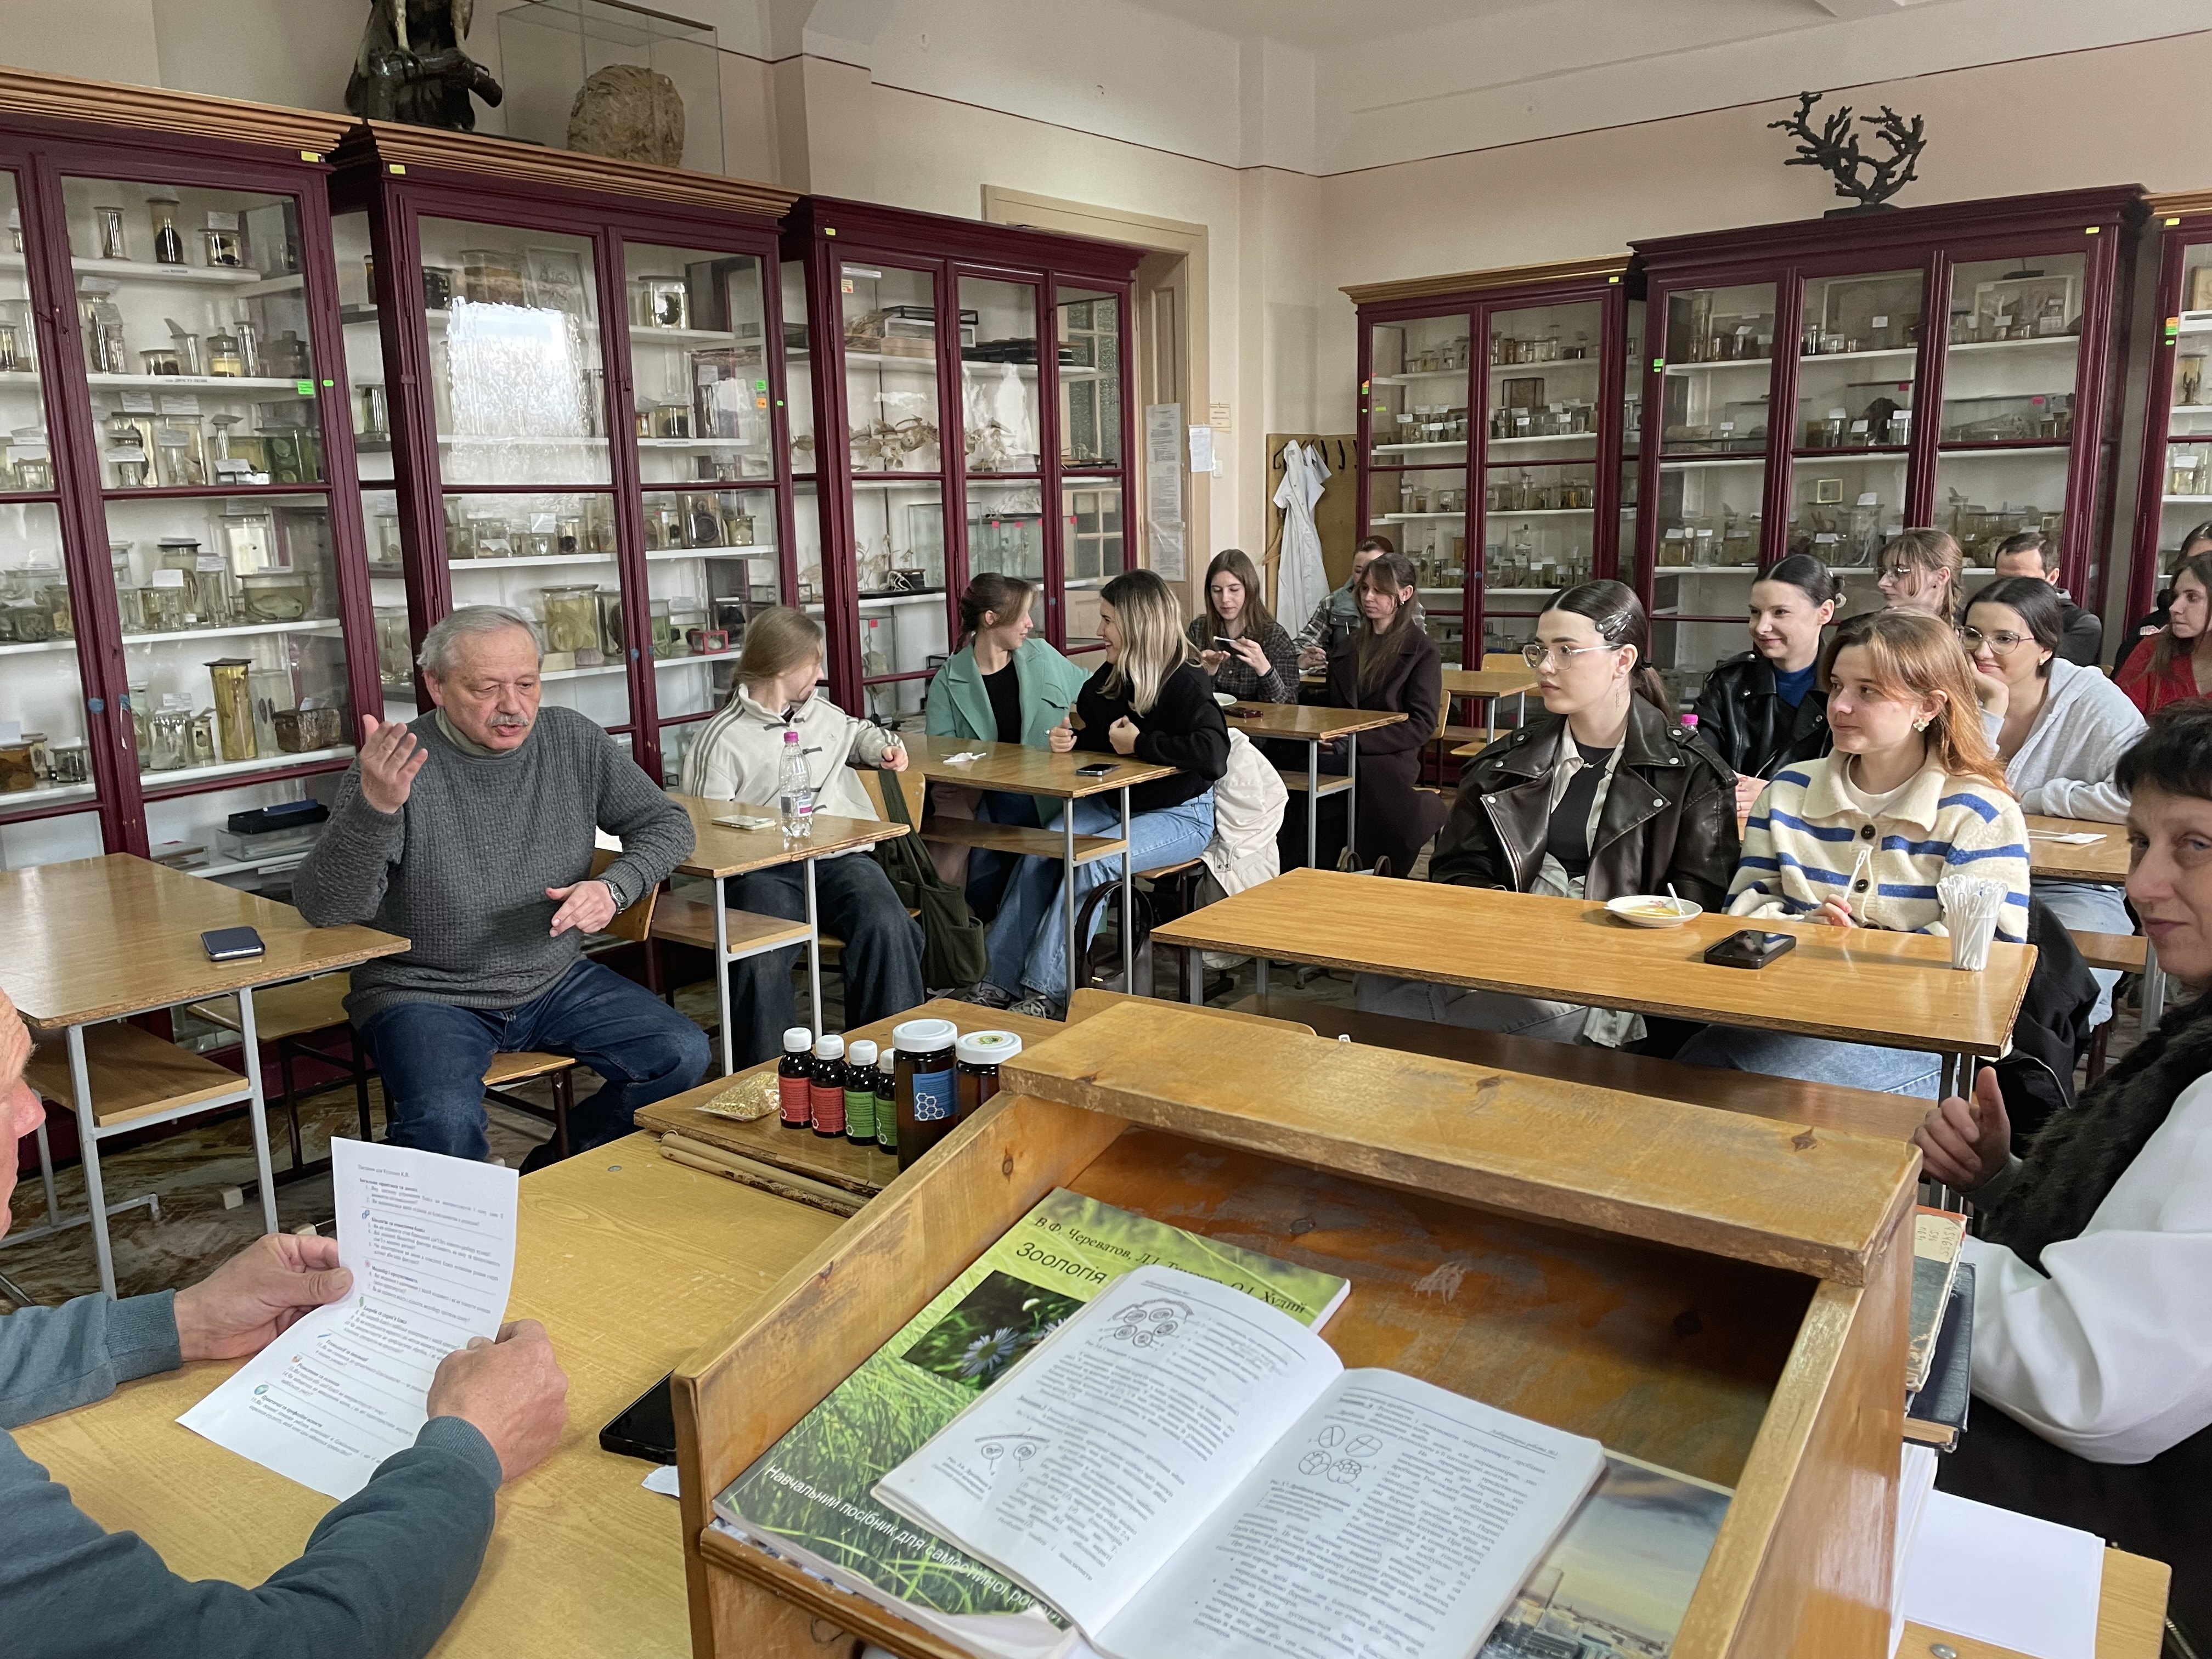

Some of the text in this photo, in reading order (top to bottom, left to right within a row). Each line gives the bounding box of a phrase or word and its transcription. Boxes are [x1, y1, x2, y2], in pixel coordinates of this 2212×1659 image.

[1035, 1217, 1062, 1234] В.Ф.
[1069, 1228, 1132, 1260] Череватов,
[1017, 1242, 1108, 1285] Зоологія
[764, 1464, 841, 1509] Навчальний
[839, 1501, 899, 1537] посібник
[893, 1530, 926, 1550] для
[925, 1545, 1011, 1595] самостійної
